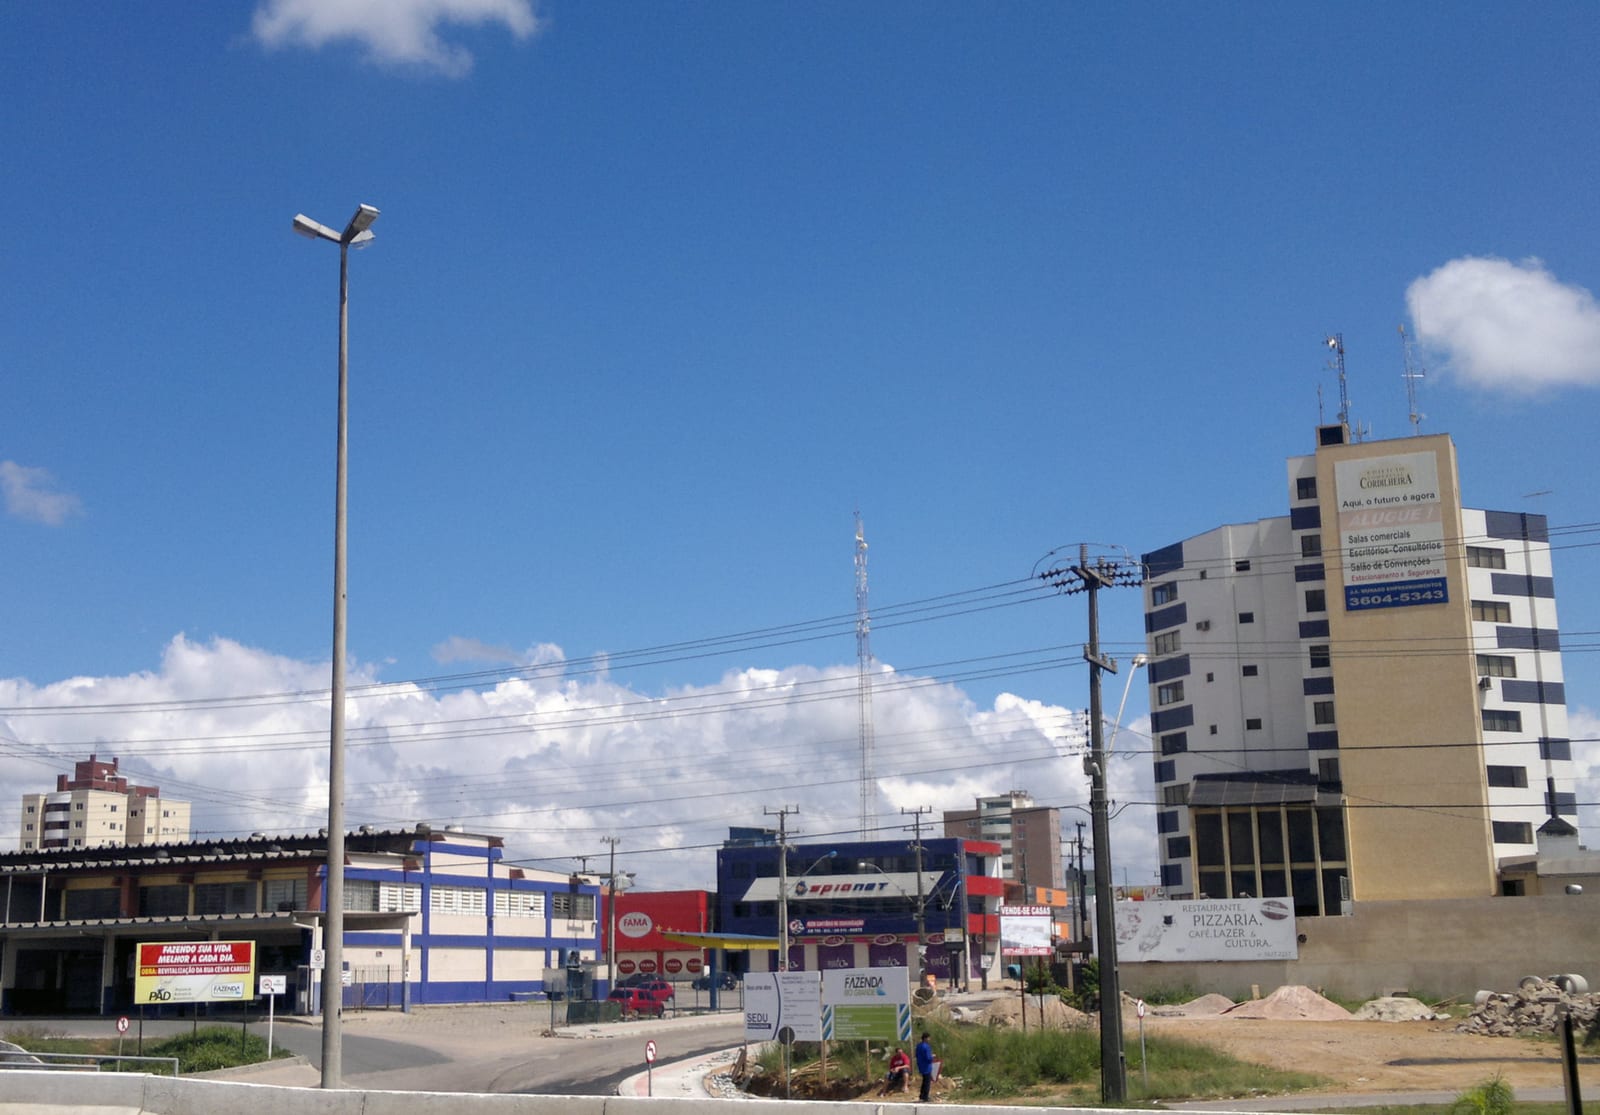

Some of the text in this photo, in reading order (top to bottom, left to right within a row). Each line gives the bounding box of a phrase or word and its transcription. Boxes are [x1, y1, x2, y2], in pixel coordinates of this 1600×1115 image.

[1374, 496, 1400, 504] futuro
[1410, 492, 1436, 502] agora
[1349, 508, 1422, 527] ALUGUE
[1348, 531, 1410, 544] Salas comerciais
[1350, 558, 1430, 572] Salão de Convenções
[1352, 572, 1400, 582] Estacionamento
[1408, 569, 1440, 577] Segurança
[1350, 590, 1444, 606] 3604-5343
[1032, 906, 1050, 914] CASAS
[624, 918, 648, 926] FAMA
[1214, 929, 1244, 938] LAZER
[162, 944, 232, 954] FAZENDO SUA VIDA
[158, 954, 234, 964] MELHOR A CADA DIA.
[158, 966, 195, 975] REVITALIZAÇÃO
[196, 966, 203, 974] DA
[204, 966, 214, 974] RUA
[844, 976, 884, 988] FAZENDA
[149, 991, 171, 1000] PAD
[747, 1013, 768, 1022] SEDU
